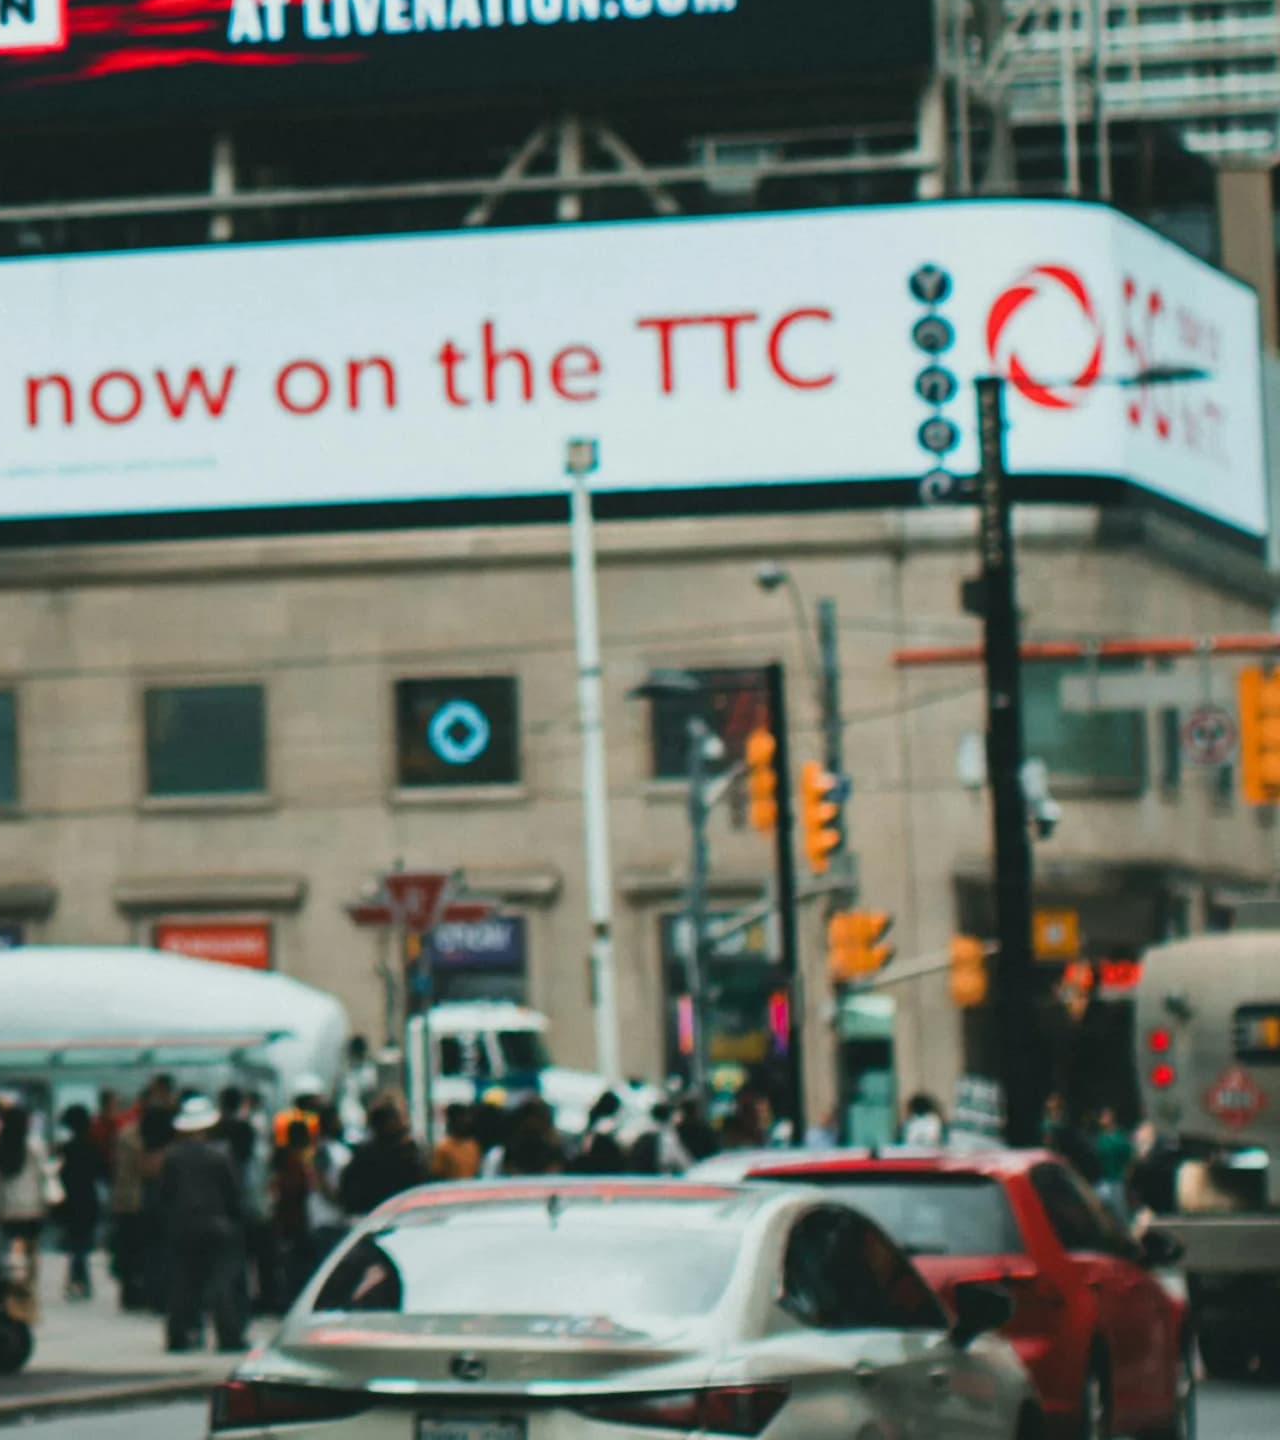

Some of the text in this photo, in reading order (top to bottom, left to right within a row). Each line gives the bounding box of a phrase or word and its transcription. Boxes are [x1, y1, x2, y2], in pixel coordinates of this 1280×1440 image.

[24, 365, 237, 428] now
[273, 355, 398, 417] on
[436, 320, 605, 408] the
[636, 306, 837, 396] TTC
